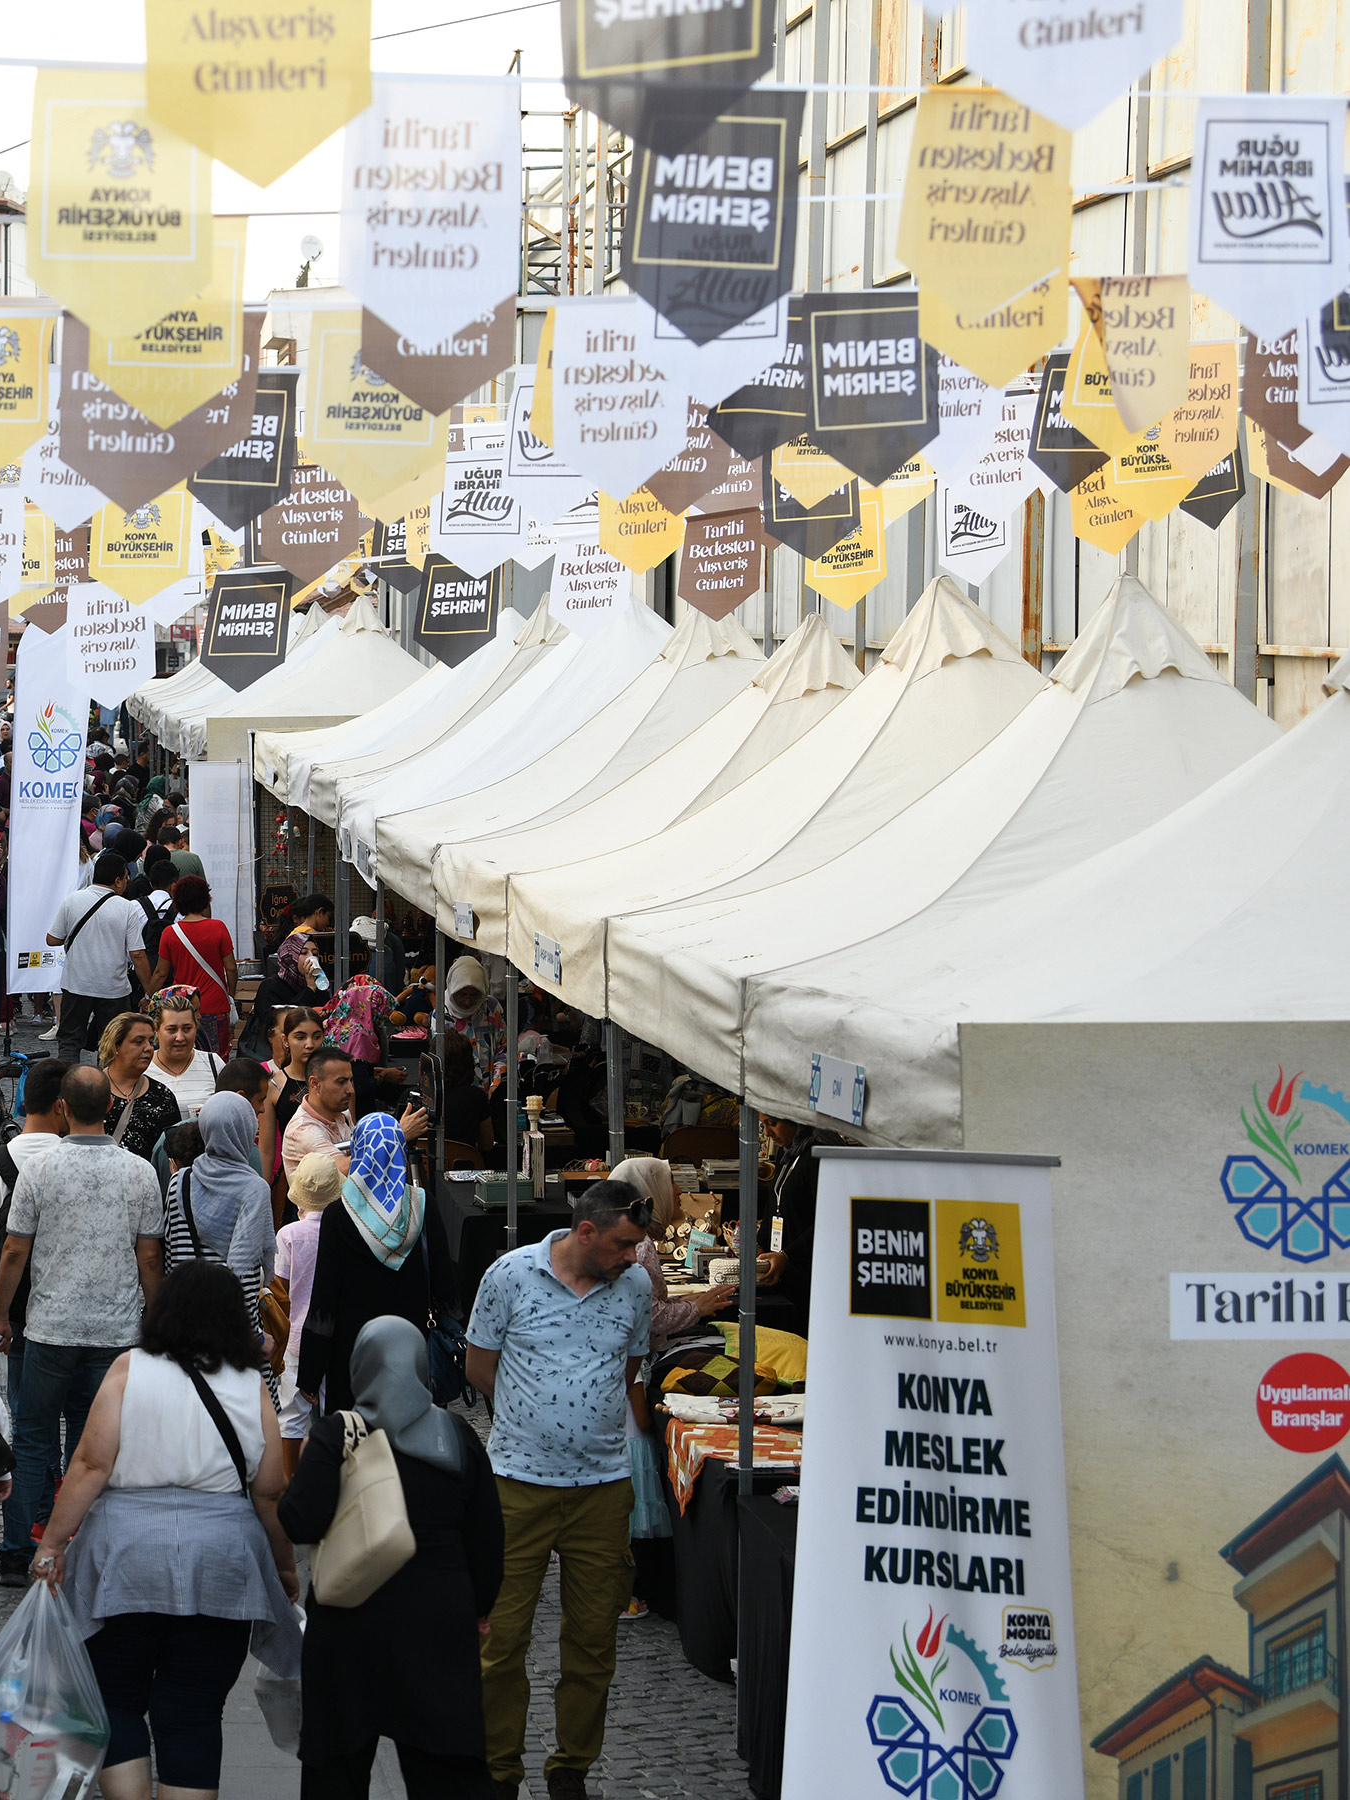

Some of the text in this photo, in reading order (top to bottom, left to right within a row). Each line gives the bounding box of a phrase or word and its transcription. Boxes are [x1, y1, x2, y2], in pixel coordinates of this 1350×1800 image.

[182, 7, 337, 45] Alışveriş
[1019, 3, 1144, 51] Günleri
[194, 57, 326, 95] Günleri
[141, 342, 202, 353] BELEDİYESİ
[969, 467, 1023, 487] Günleri
[1135, 464, 1172, 474] BELEDİYESİ
[446, 491, 514, 522] Altay
[277, 510, 343, 526] Alışveriş
[619, 518, 667, 536] Günleri
[124, 533, 157, 541] KONYA
[281, 528, 339, 545] Günleri
[703, 520, 744, 539] Tarihi
[107, 541, 173, 553] BÜYÜKŞEHİR
[689, 538, 755, 559] Bedesten
[835, 542, 861, 552] KONYA
[694, 555, 748, 574] Alışveriş
[821, 550, 874, 564] BÜYÜKŞEHİR
[832, 561, 864, 570] BELEDİYESİ
[564, 576, 618, 593] Alışveriş
[696, 574, 744, 591] Günleri
[566, 595, 612, 611] Günleri
[1294, 1143, 1349, 1156] KOMEK
[962, 1267, 999, 1281] KONYA
[945, 1279, 1016, 1301] BÜYÜKŞEHİR
[959, 1299, 1004, 1312] BELEDİYESİ
[1185, 1278, 1325, 1324] Tarihi
[884, 1333, 998, 1354] www.konya.bel.tr
[897, 1372, 993, 1417] KONYA
[1271, 1409, 1344, 1431] Branşlar
[884, 1430, 1008, 1477] MESLEK
[855, 1480, 1032, 1538] EDİNDİRME
[864, 1545, 1025, 1596] KURSLARI
[1006, 1614, 1050, 1628] KONYA
[939, 1688, 982, 1707] KOMEK
